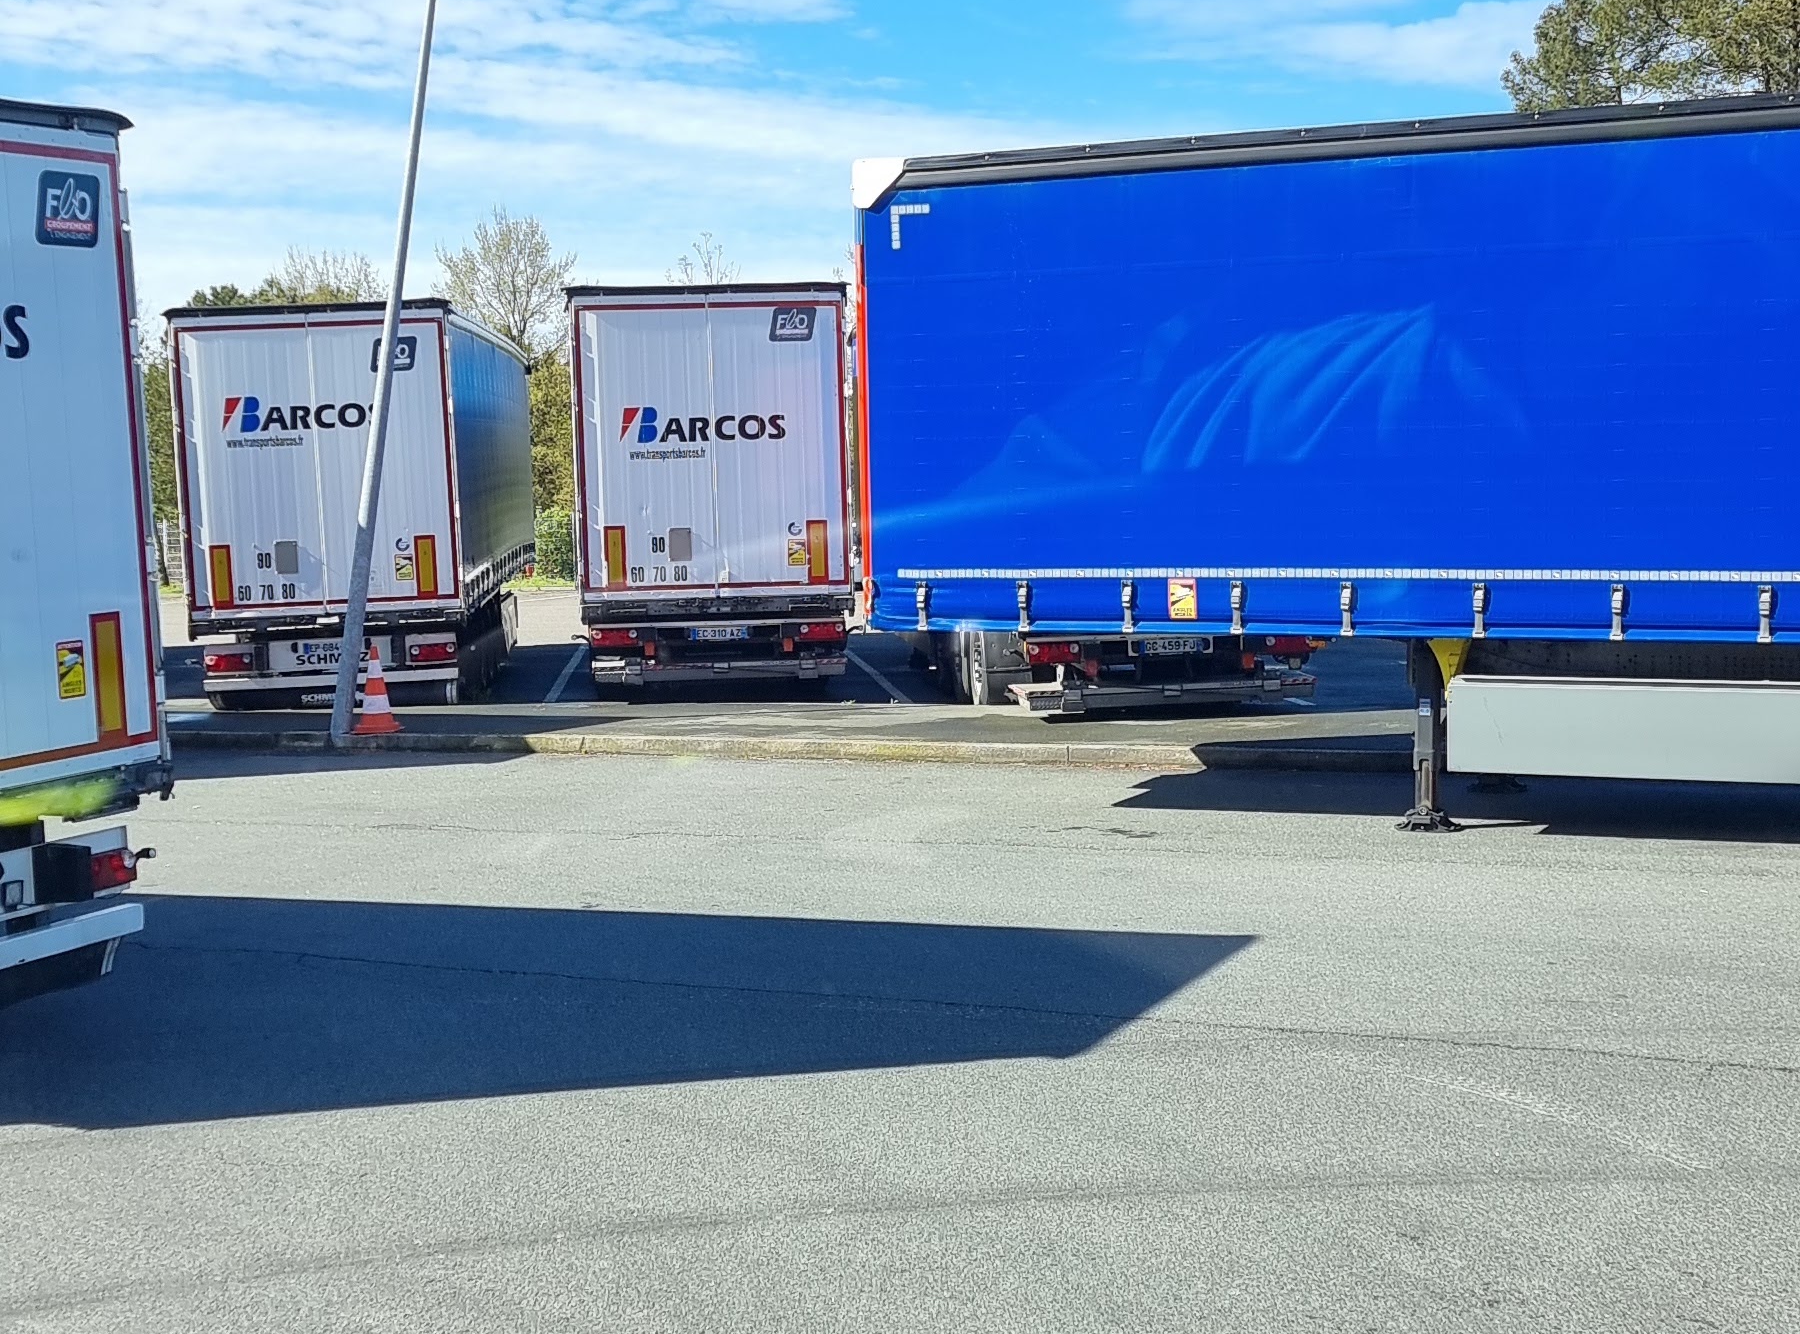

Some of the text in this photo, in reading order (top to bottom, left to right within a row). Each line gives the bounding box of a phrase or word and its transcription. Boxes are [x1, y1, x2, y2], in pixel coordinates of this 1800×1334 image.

[0, 304, 29, 359] S
[637, 407, 786, 443] BARCOS
[257, 552, 272, 569] 90
[631, 565, 688, 583] 60 70 80
[238, 582, 296, 601] 60 70 80
[296, 652, 369, 666] SCHMZ
